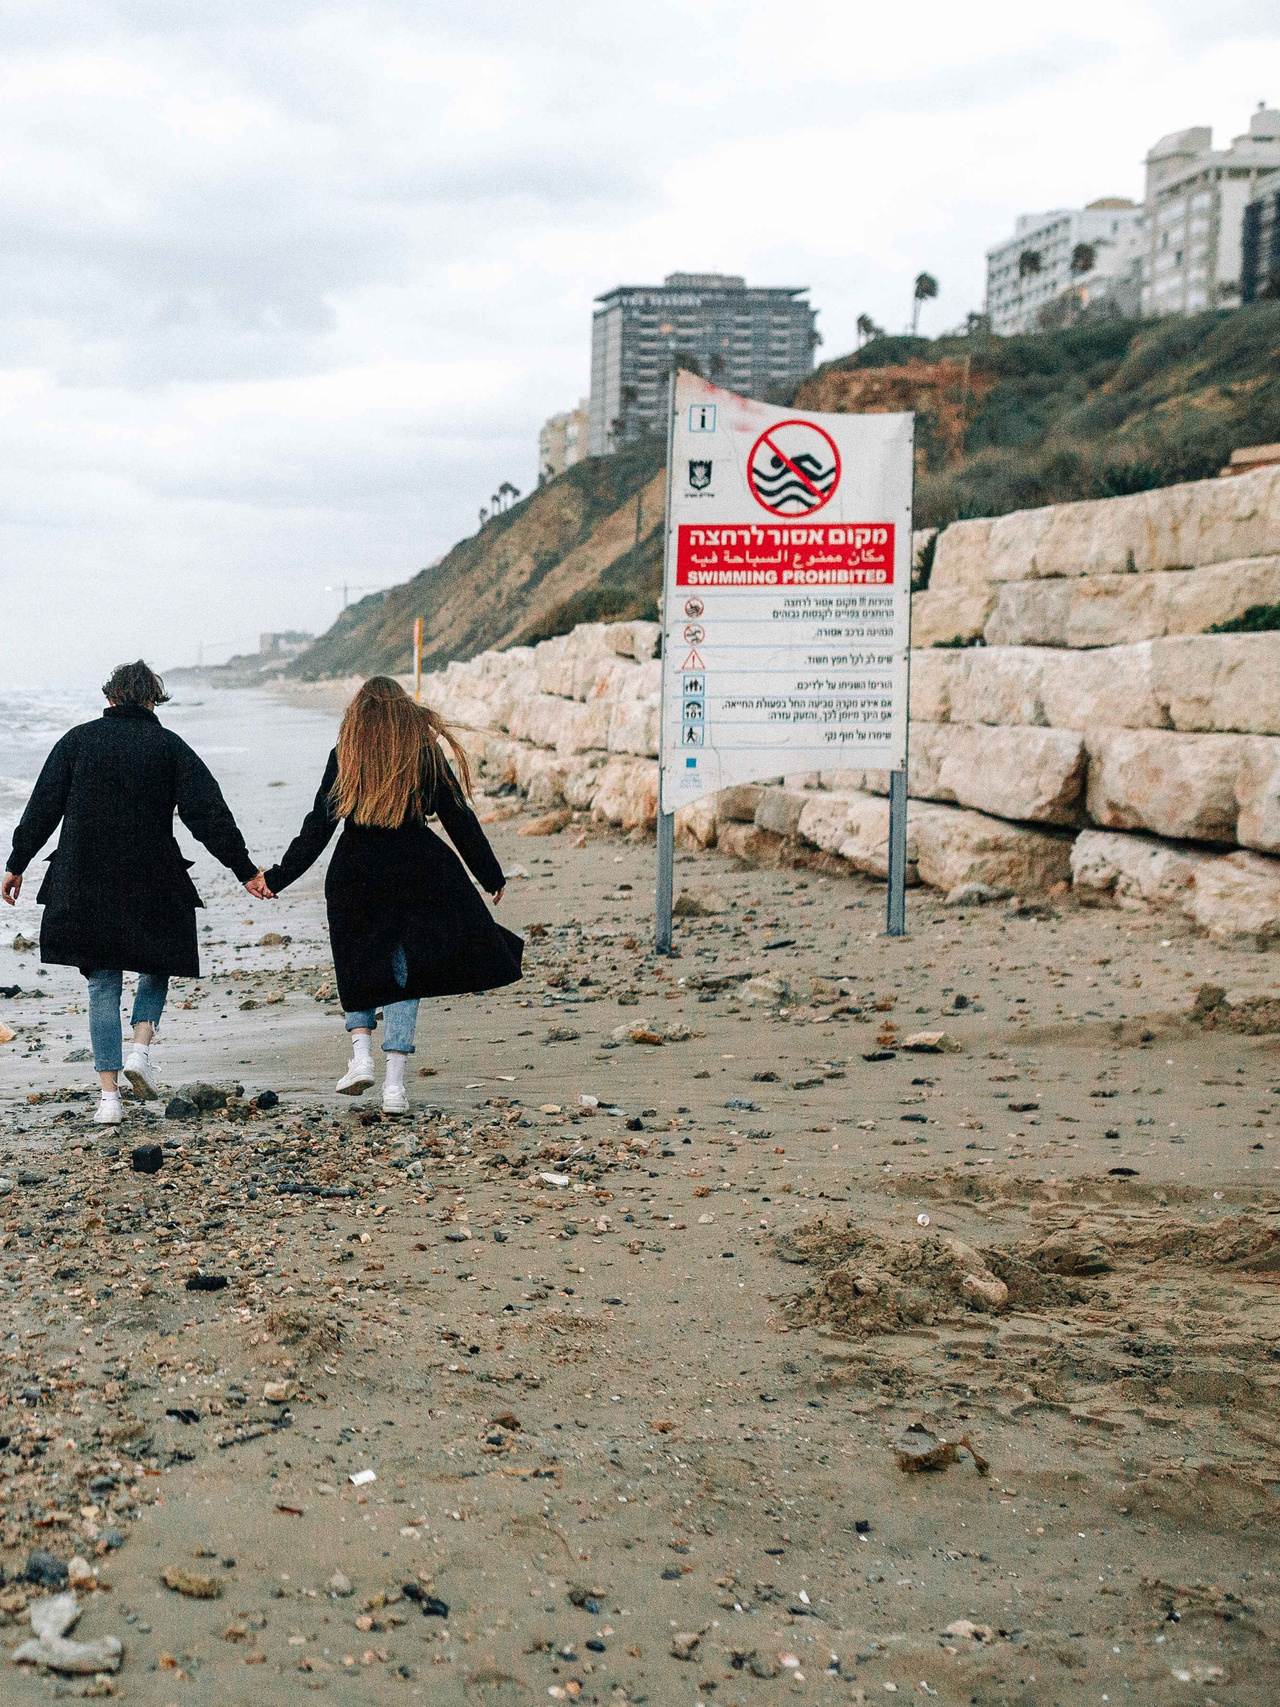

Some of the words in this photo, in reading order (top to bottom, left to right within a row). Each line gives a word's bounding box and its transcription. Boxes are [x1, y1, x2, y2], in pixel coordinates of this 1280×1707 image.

[689, 525, 764, 546] לרחצה
[767, 528, 824, 546] אסור
[827, 527, 888, 549] מקום
[691, 550, 718, 567] فيه
[723, 549, 788, 567] السباحة
[793, 550, 842, 569] ممنوع
[847, 549, 885, 567] مكان
[688, 570, 778, 584] SWIMMING
[782, 569, 887, 584] PROHIBITED
[784, 597, 811, 607] לרחצה
[815, 598, 833, 606] אסור
[836, 598, 857, 608] מקום
[831, 656, 848, 667] חפץ
[849, 653, 863, 665] לכל
[865, 653, 875, 665] לב
[877, 655, 893, 664] שים
[825, 678, 836, 690] על
[880, 699, 892, 708] אם
[685, 711, 702, 719] 101
[880, 711, 892, 720] אם
[839, 731, 854, 743] חוף
[856, 728, 867, 740] על
